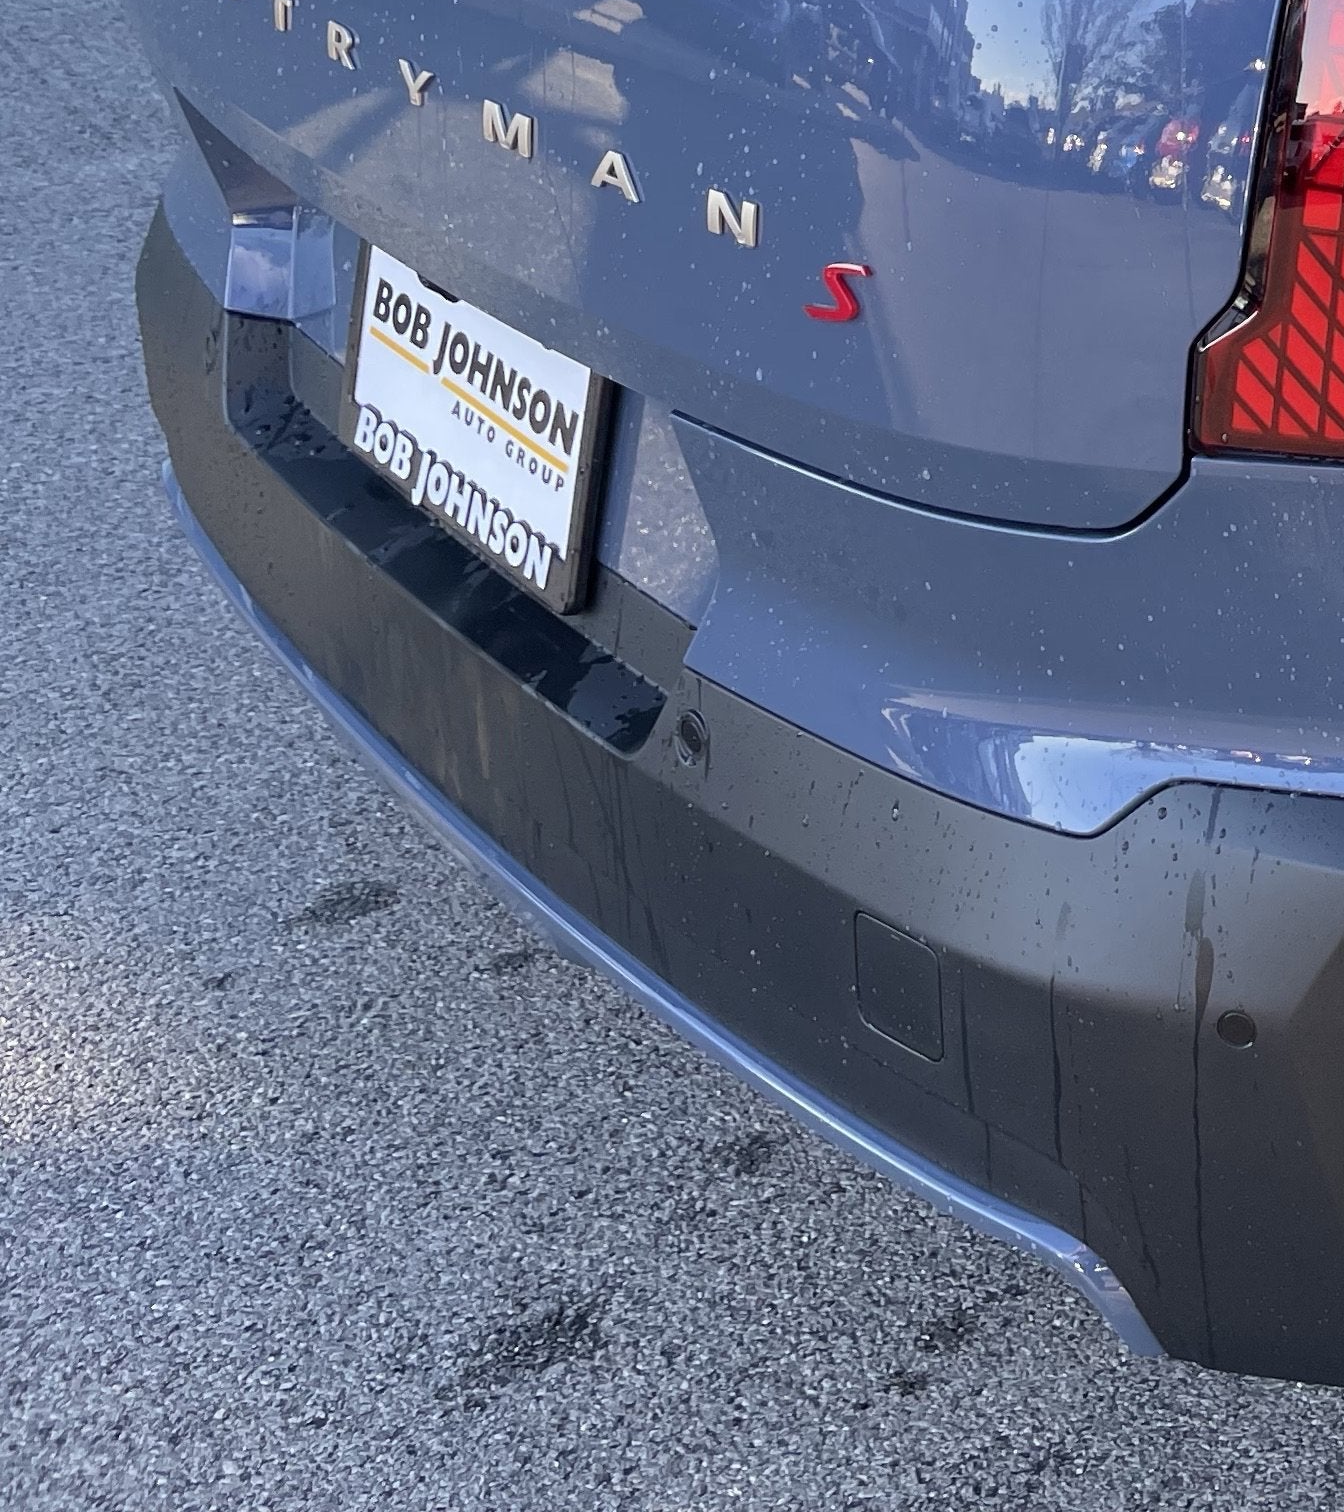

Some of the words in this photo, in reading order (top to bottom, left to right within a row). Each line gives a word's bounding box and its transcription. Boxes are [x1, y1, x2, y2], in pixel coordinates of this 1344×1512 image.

[803, 262, 873, 323] S
[373, 277, 432, 349] BOB
[432, 321, 580, 456] JOHNSON
[353, 405, 416, 480] BOB
[410, 450, 554, 590] JOHNSON
[451, 401, 497, 444] AUTO
[506, 439, 566, 493] GROUP
